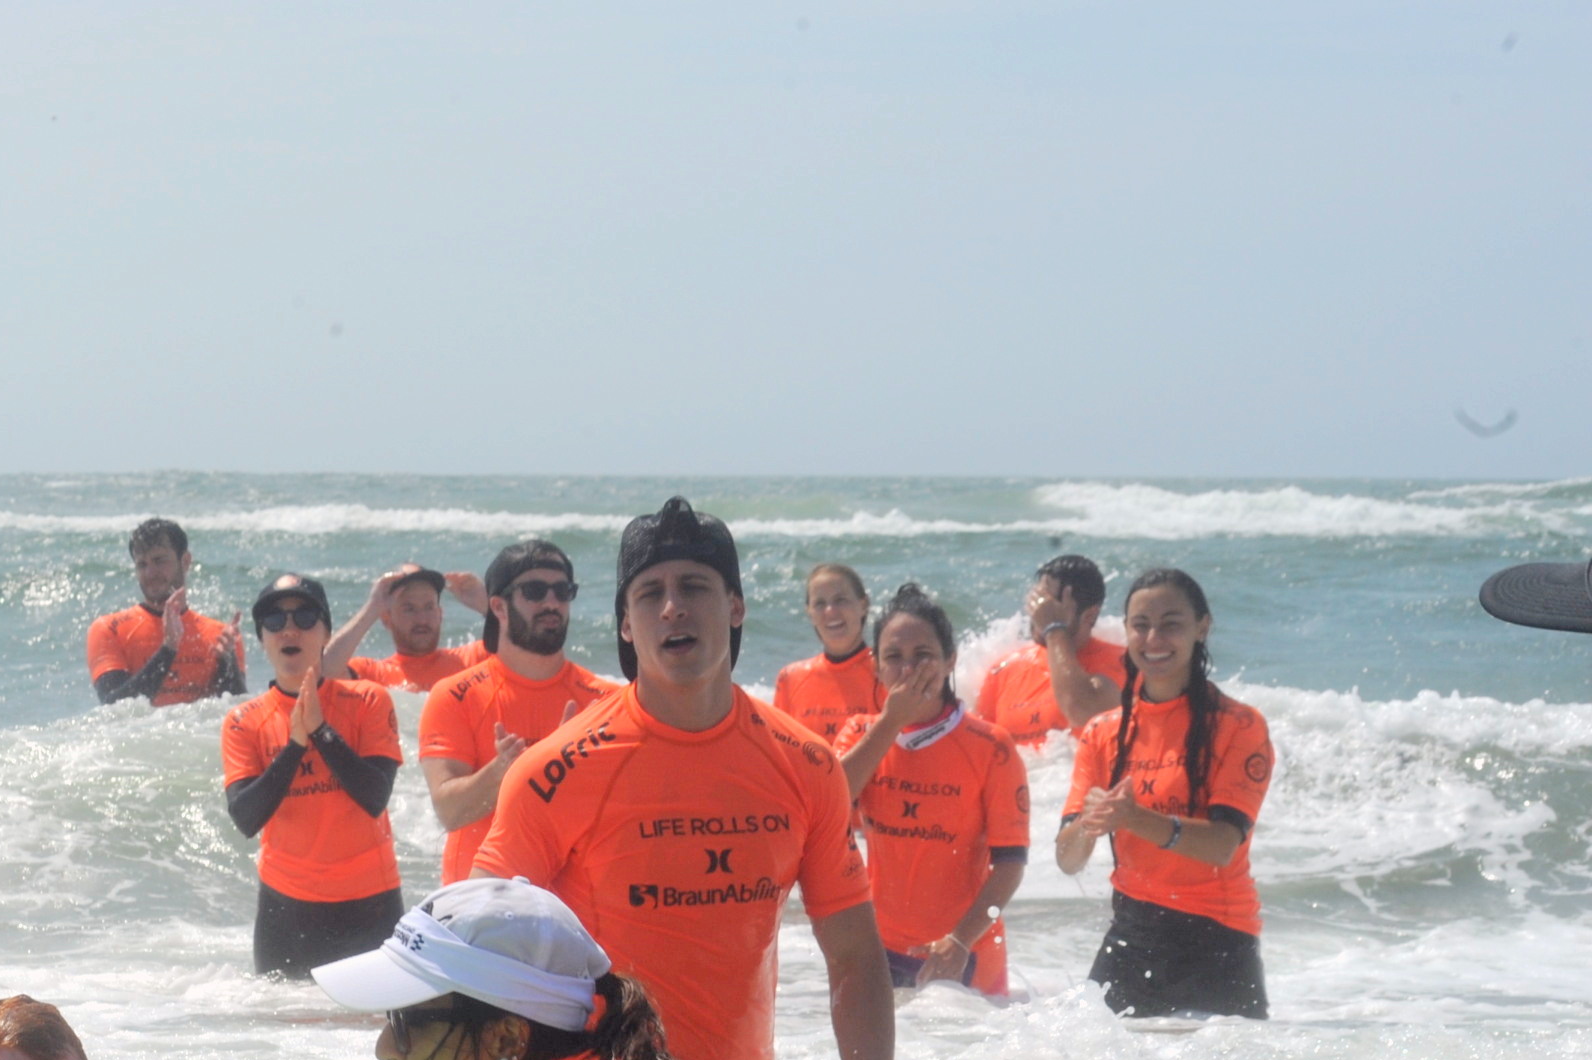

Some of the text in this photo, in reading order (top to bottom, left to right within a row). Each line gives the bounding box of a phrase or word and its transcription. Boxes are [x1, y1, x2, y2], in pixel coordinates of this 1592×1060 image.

[528, 721, 616, 803] LoFric
[639, 813, 791, 839] LIFE ROLLS ON
